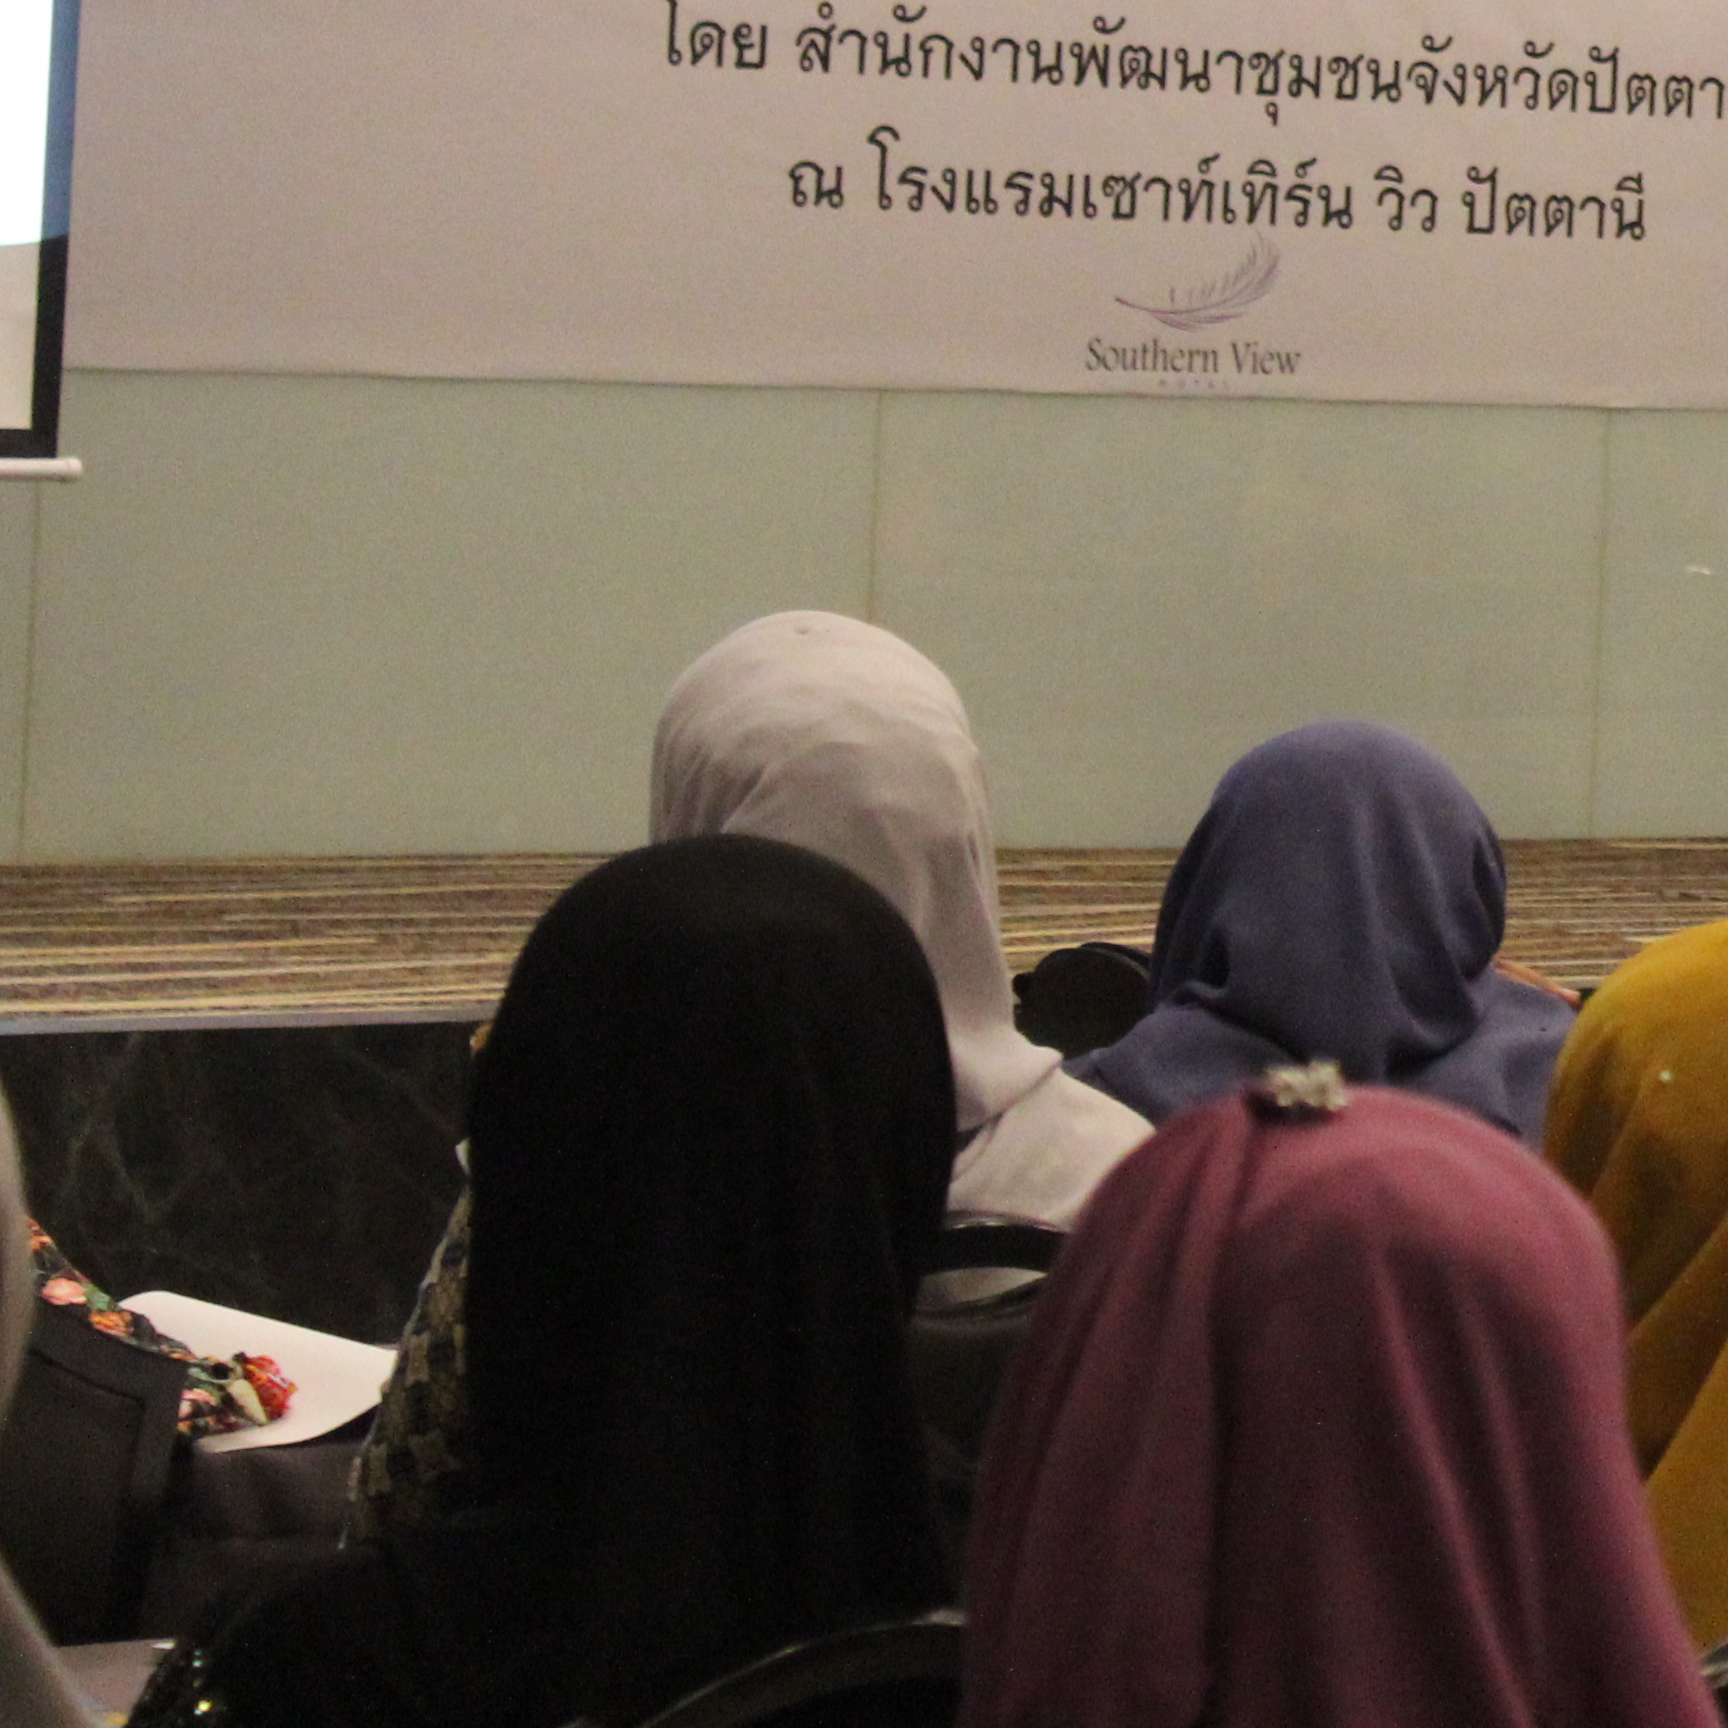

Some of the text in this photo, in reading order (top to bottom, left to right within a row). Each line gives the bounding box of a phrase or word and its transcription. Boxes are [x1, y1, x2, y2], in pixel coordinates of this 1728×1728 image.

[788, 127, 1648, 243] ณ โรงแรมเซาท์เทิร์น วิว ปัตตานี
[1085, 337, 1302, 375] Southern View
